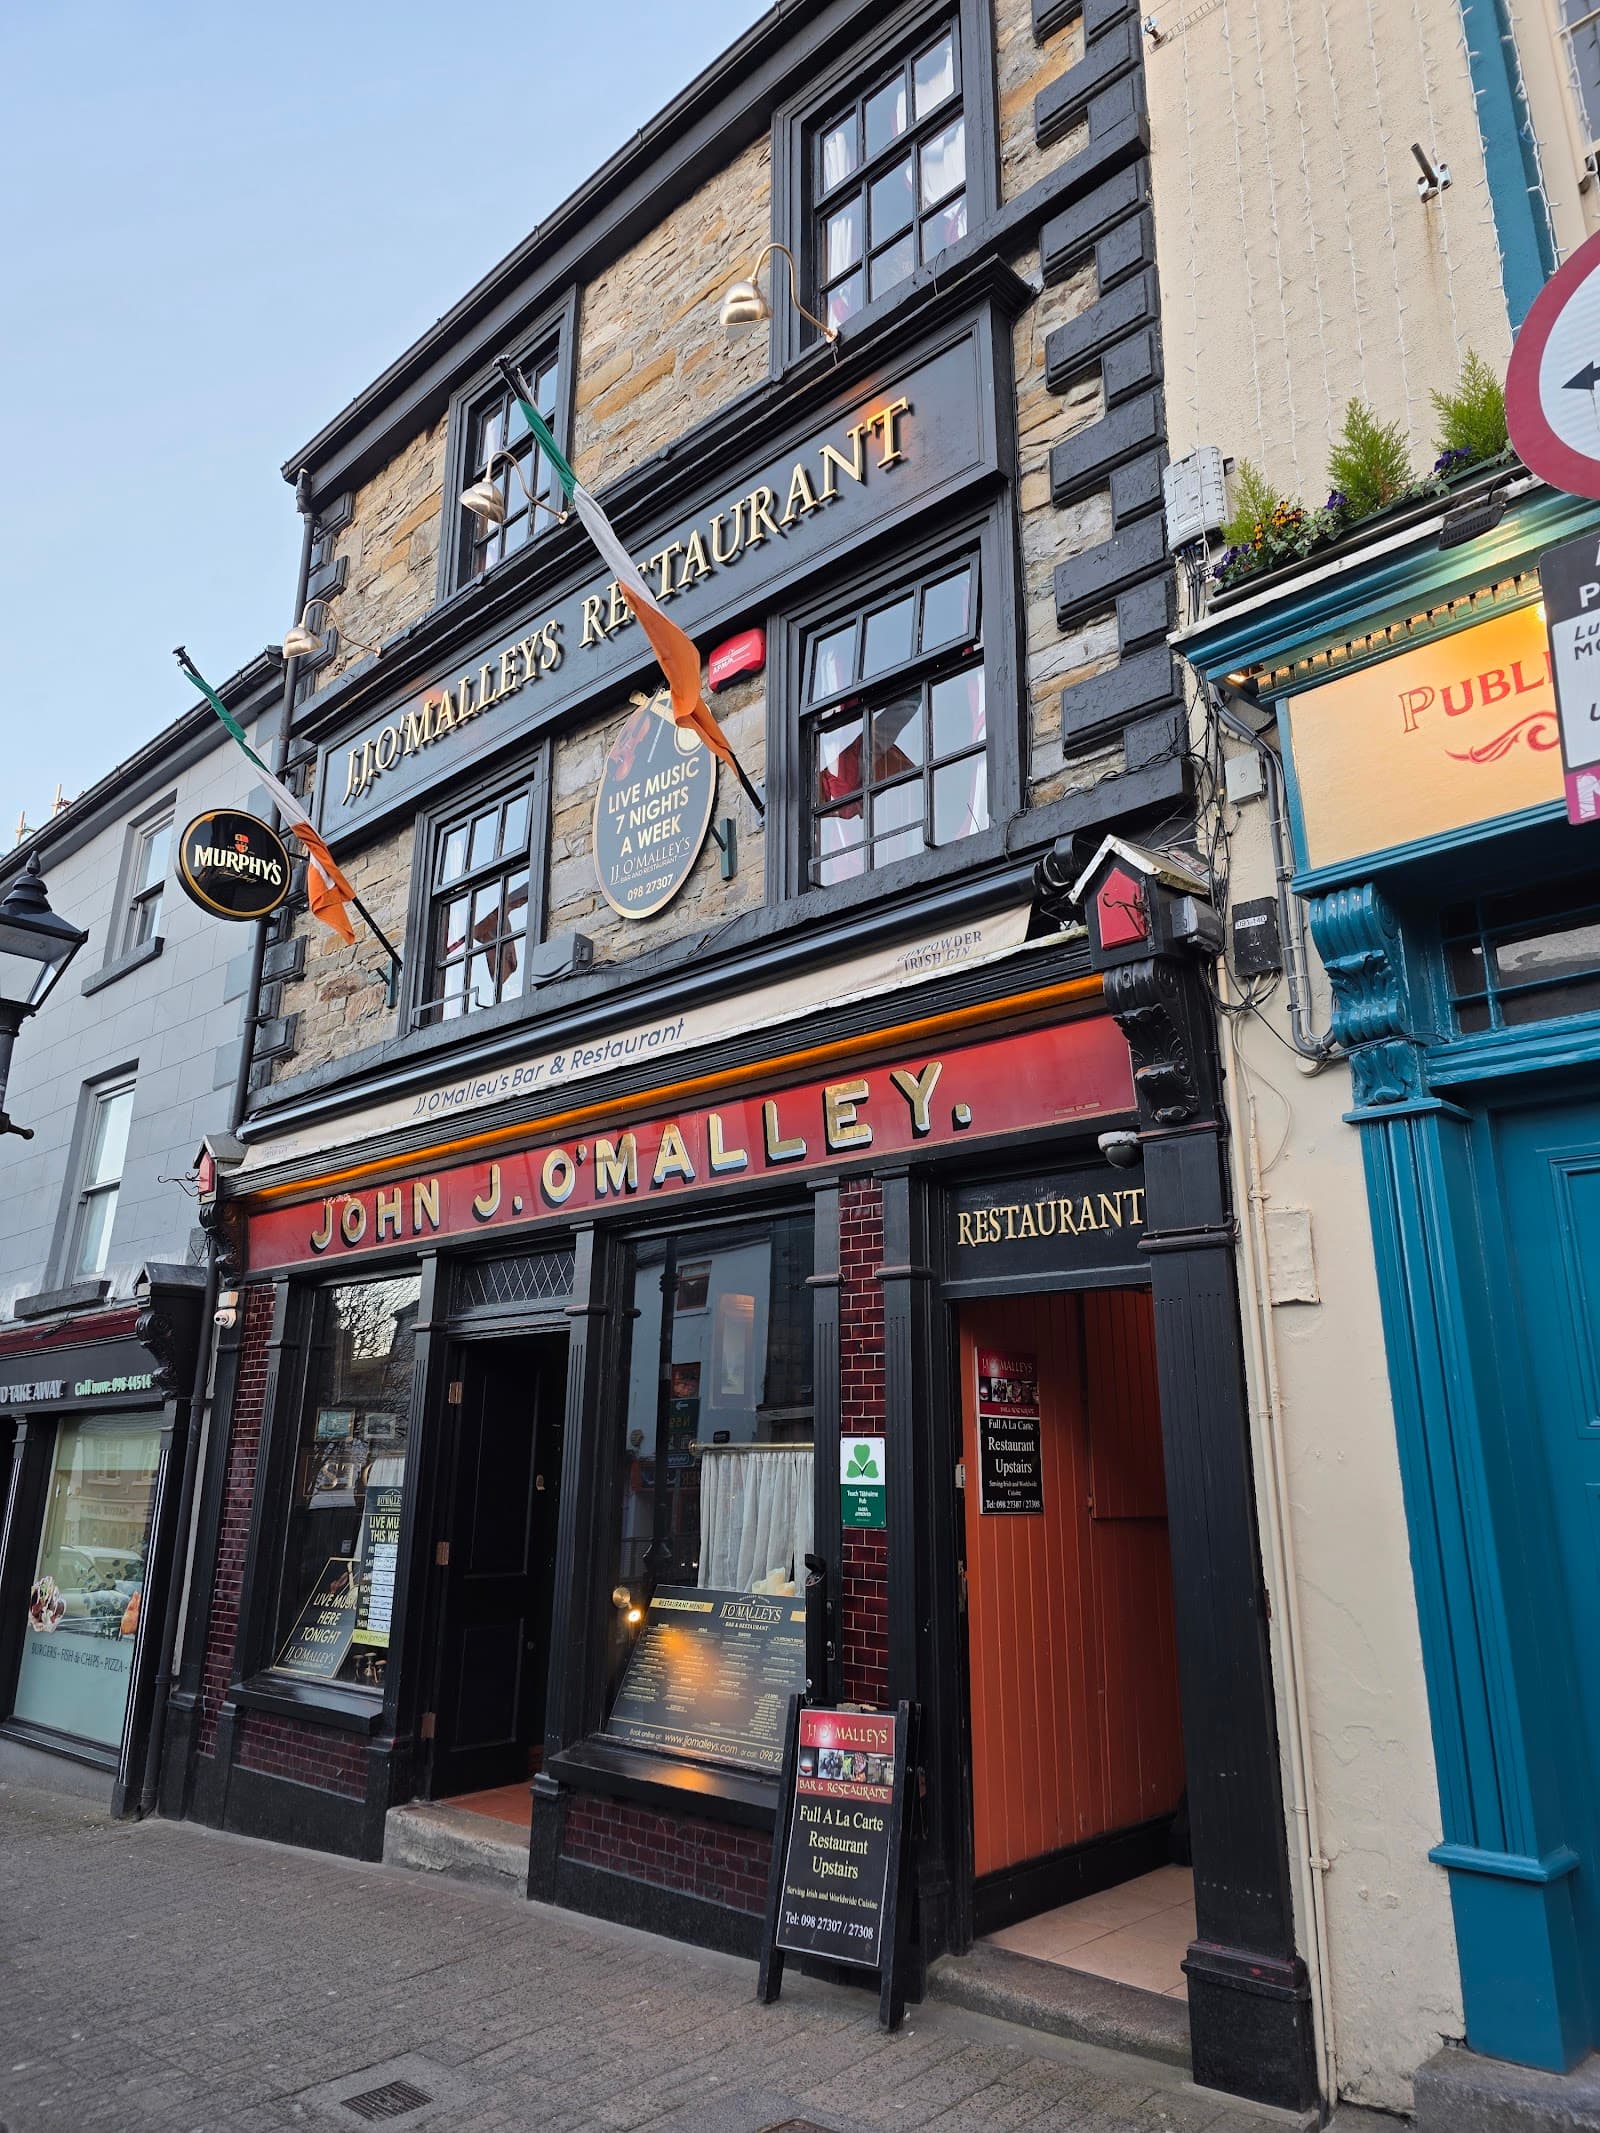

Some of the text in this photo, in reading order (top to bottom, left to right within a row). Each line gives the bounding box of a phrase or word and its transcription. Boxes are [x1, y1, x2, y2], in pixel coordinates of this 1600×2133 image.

[579, 397, 908, 649] RETAURANT
[608, 757, 700, 815] LIVE MUSIC
[615, 786, 689, 835] 7 NIGHTS
[620, 813, 683, 858] A WEEK
[194, 844, 282, 886] MURPHY'S
[627, 873, 674, 901] 098 27307
[904, 946, 970, 972] IRISH GIN
[428, 1074, 508, 1112] O'Malley's
[512, 1064, 544, 1088] Bar
[550, 1055, 564, 1075] &
[570, 1017, 685, 1071] Restaurant
[310, 1060, 972, 1250] JOHN J. O'MALLEY.
[957, 1188, 1145, 1248] RESTAURANT
[988, 1418, 1001, 1430] Full
[1002, 1420, 1008, 1431] A
[1008, 1420, 1016, 1431] La
[988, 1437, 1035, 1452] Restaurant
[995, 1459, 1033, 1477] Upstairs
[369, 1515, 385, 1529] LIVE
[370, 1530, 387, 1543] THIS
[313, 1593, 335, 1608] LIVE
[317, 1611, 342, 1626] HERE
[301, 1626, 342, 1645] TONIGHT
[81, 1652, 100, 1668] CHIPS
[104, 1657, 123, 1673] PIZZA
[835, 1726, 888, 1752] MALLEYS
[759, 1750, 773, 1762] 098
[800, 1780, 817, 1791] BAR
[827, 1783, 888, 1800] RESTAURANT
[799, 1804, 884, 1832] Full A La Carte
[808, 1830, 869, 1855] Restaurant
[812, 1856, 859, 1879] Upstairs
[786, 1885, 878, 1910] Serving Irish and Worldwide Cuisine
[785, 1911, 800, 1926] Tel:
[801, 1914, 816, 1928] 098
[817, 1916, 843, 1934] 27307
[848, 1923, 874, 1940] 27308
